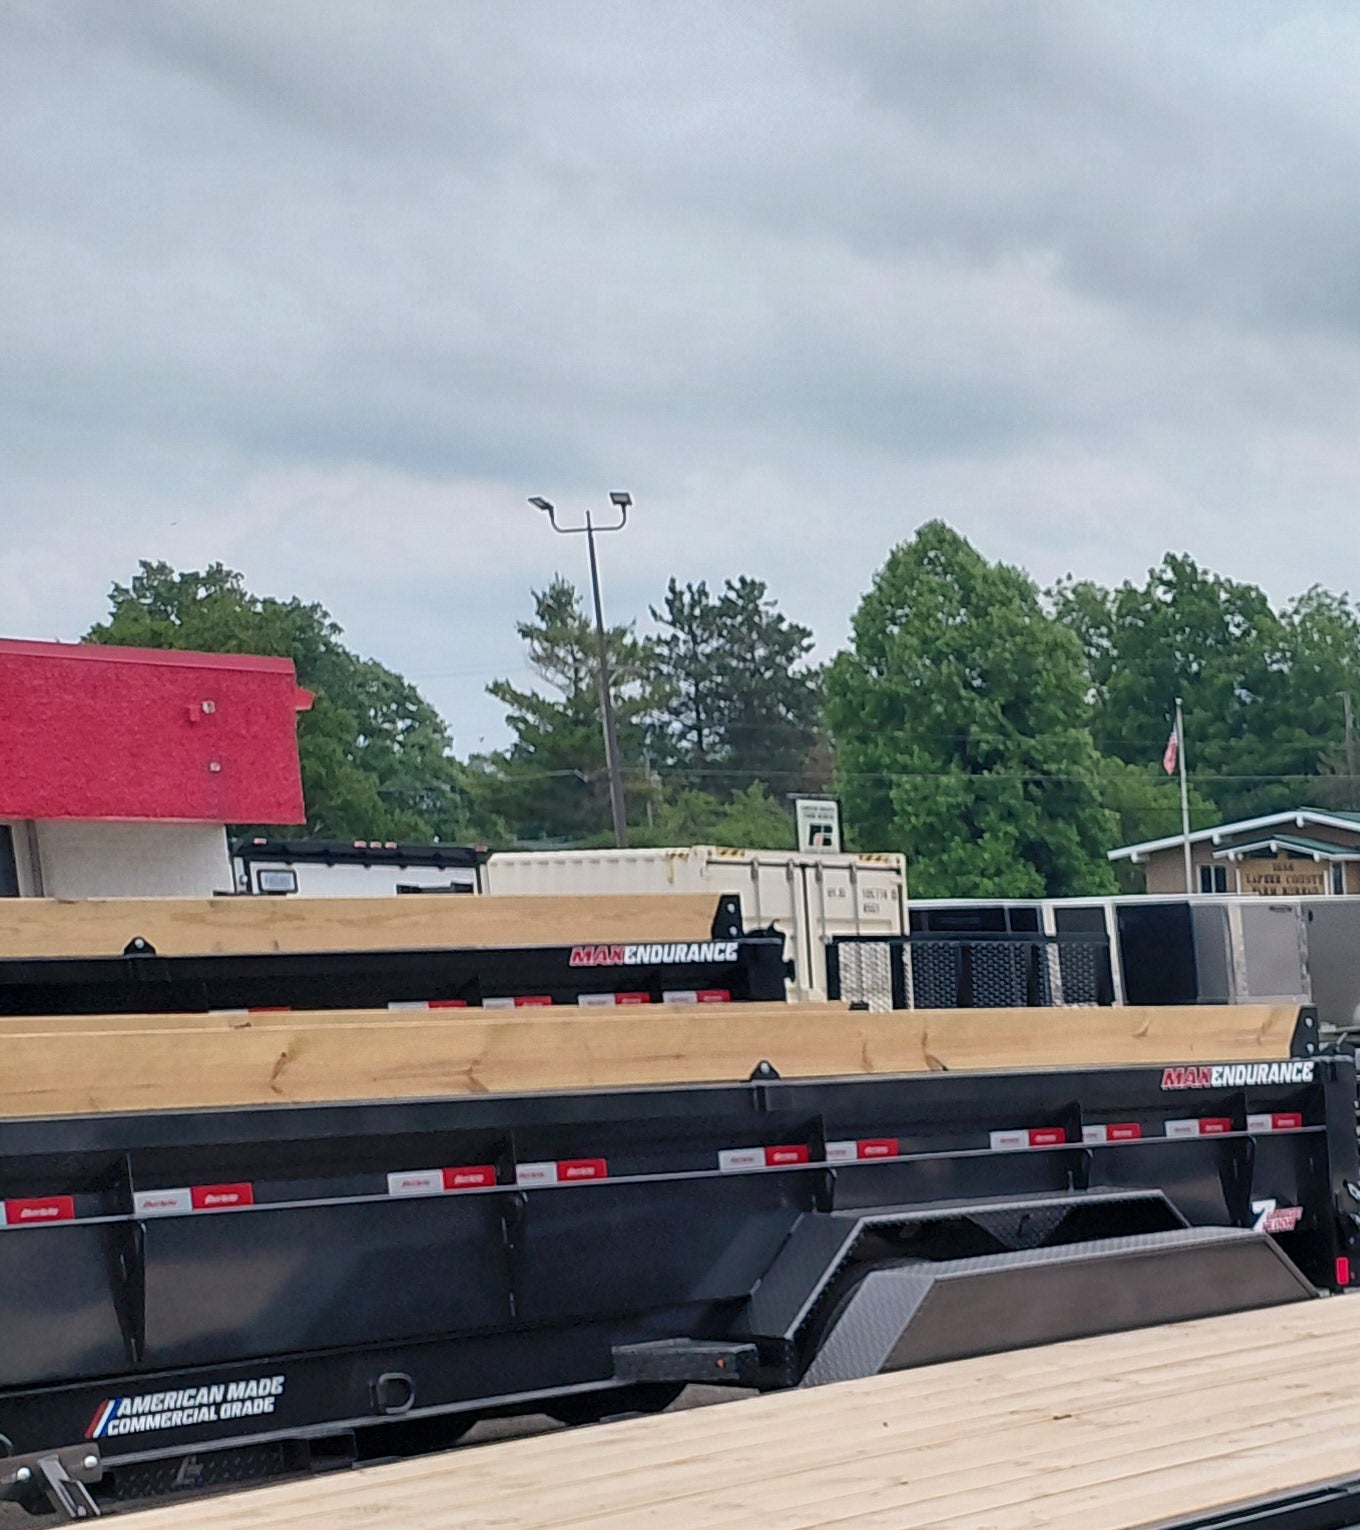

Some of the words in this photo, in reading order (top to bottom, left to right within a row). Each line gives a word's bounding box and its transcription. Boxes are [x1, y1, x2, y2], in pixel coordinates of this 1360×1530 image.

[107, 1404, 218, 1437] COMMERCIAL
[219, 1396, 275, 1420] GRADE
[117, 1384, 225, 1418] AMERICAN
[226, 1375, 285, 1401] MADE
